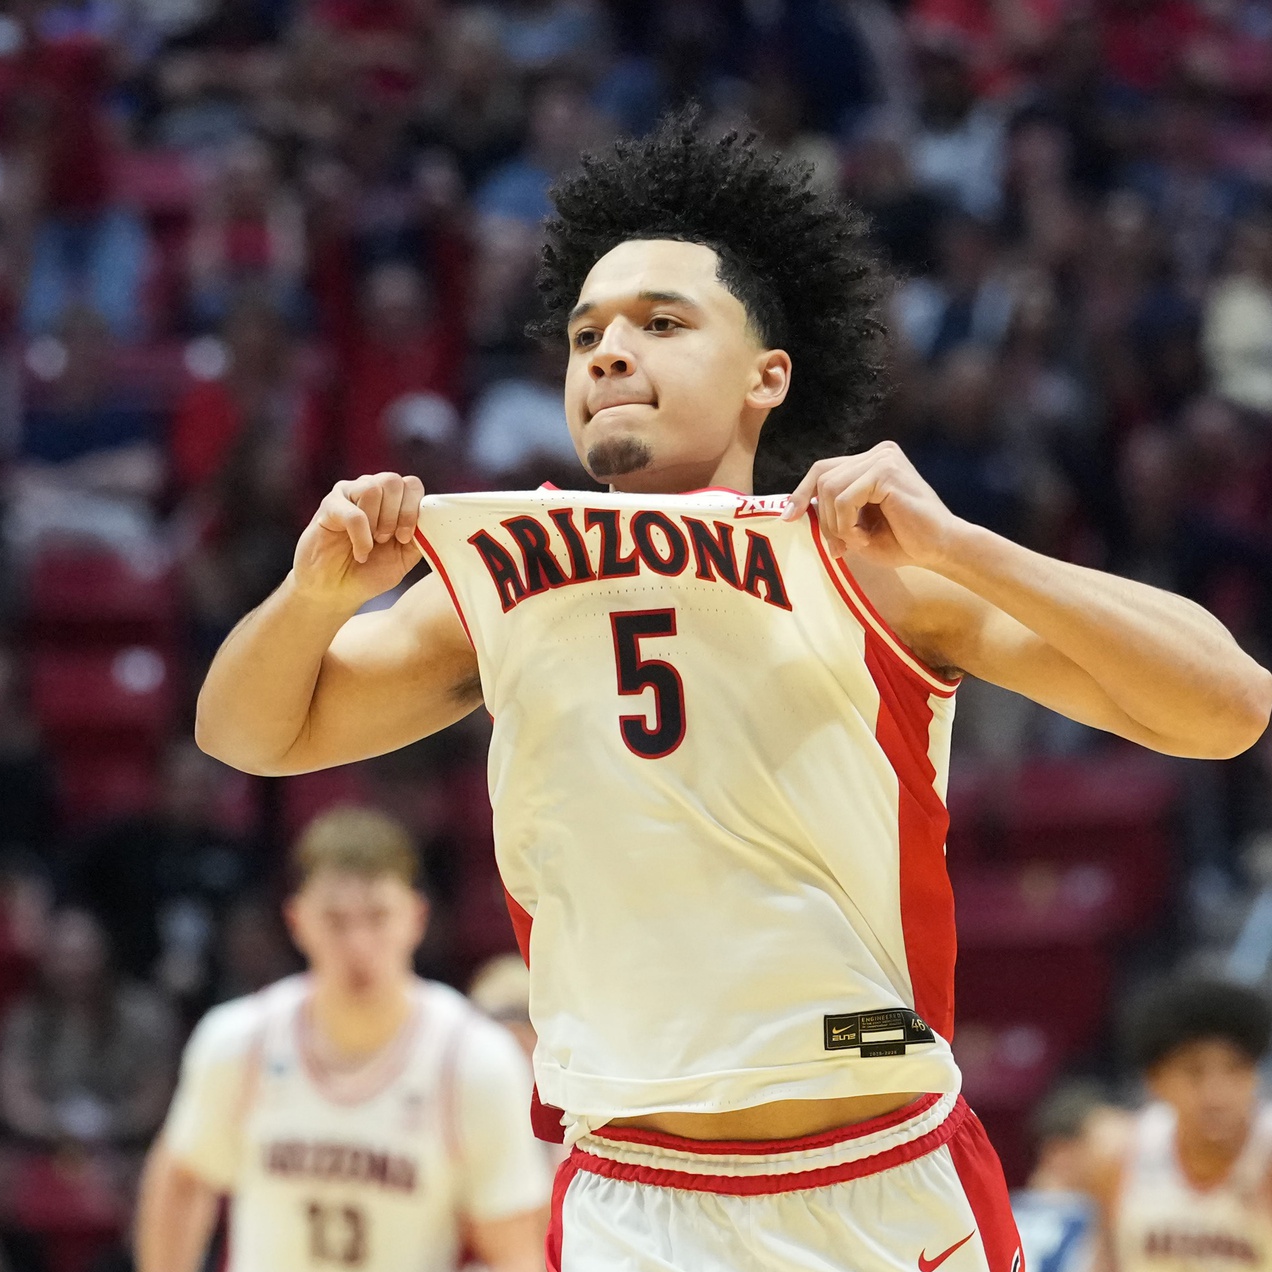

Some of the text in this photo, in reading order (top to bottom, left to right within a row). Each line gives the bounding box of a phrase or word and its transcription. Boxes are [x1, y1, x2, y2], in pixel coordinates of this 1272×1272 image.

[468, 508, 793, 613] ARIZONA
[609, 608, 687, 760] 5
[911, 1019, 926, 1032] 46
[305, 1199, 369, 1269] 13
